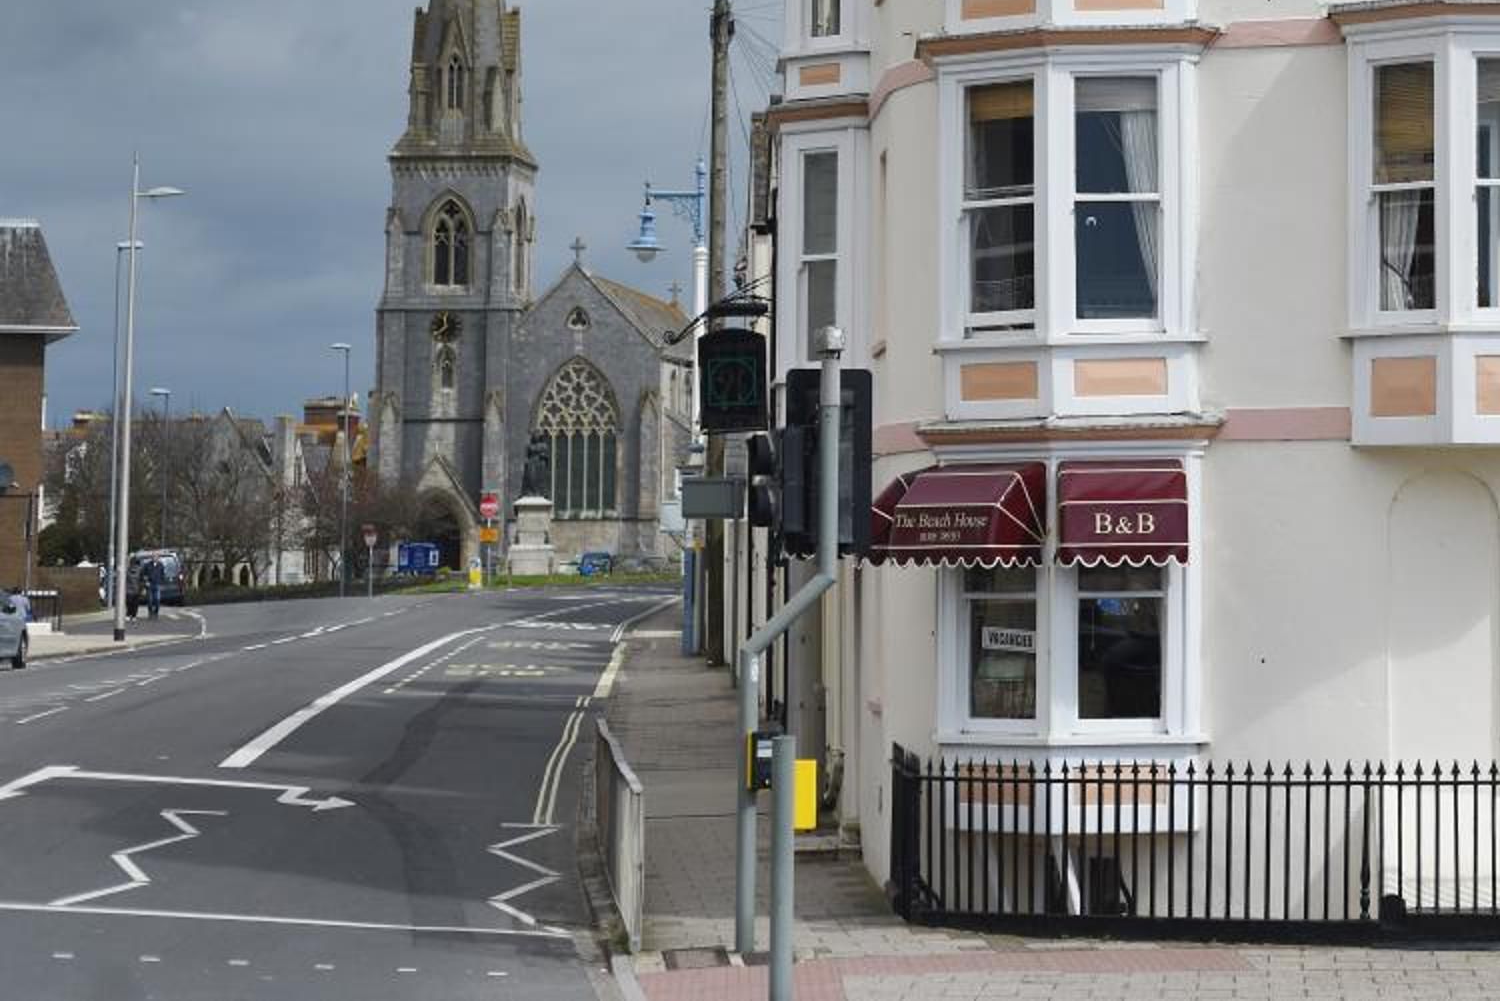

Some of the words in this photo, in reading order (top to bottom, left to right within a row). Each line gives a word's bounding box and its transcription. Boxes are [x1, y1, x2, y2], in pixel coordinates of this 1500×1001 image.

[895, 513, 917, 528] The
[918, 512, 951, 528] Beach
[953, 512, 988, 528] House
[1094, 512, 1157, 535] B&B
[988, 631, 1033, 647] VACANCIES
